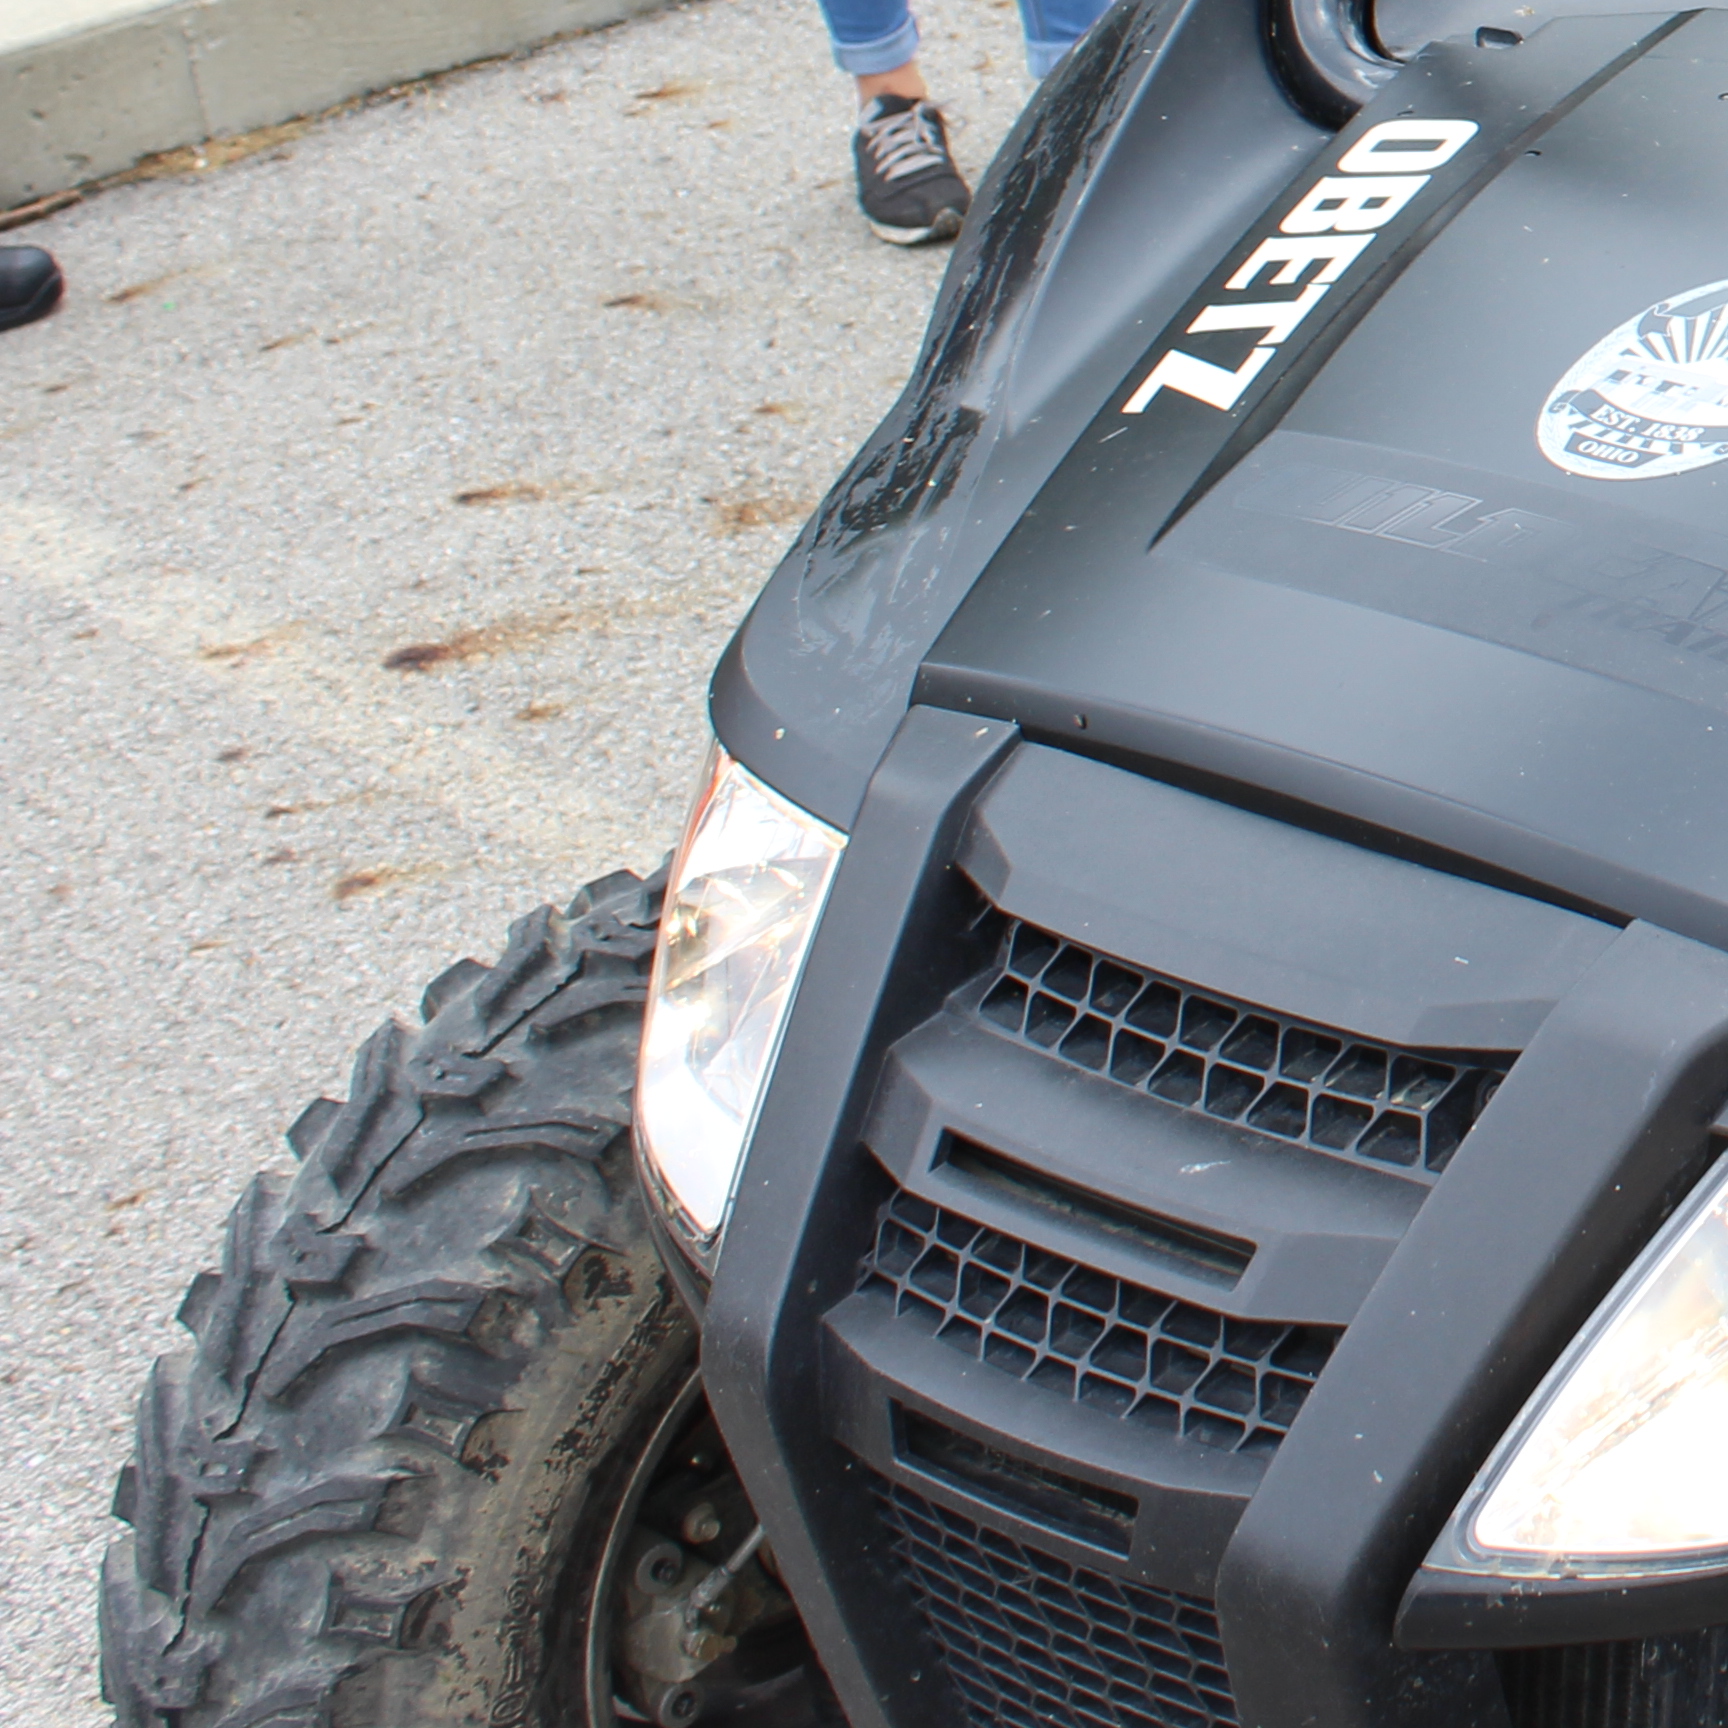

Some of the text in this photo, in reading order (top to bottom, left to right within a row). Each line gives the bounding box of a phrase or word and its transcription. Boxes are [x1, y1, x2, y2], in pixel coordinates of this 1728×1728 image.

[1121, 119, 1480, 414] OBETZ
[1590, 403, 1706, 443] EST. 1838
[1577, 440, 1640, 464] OHIO
